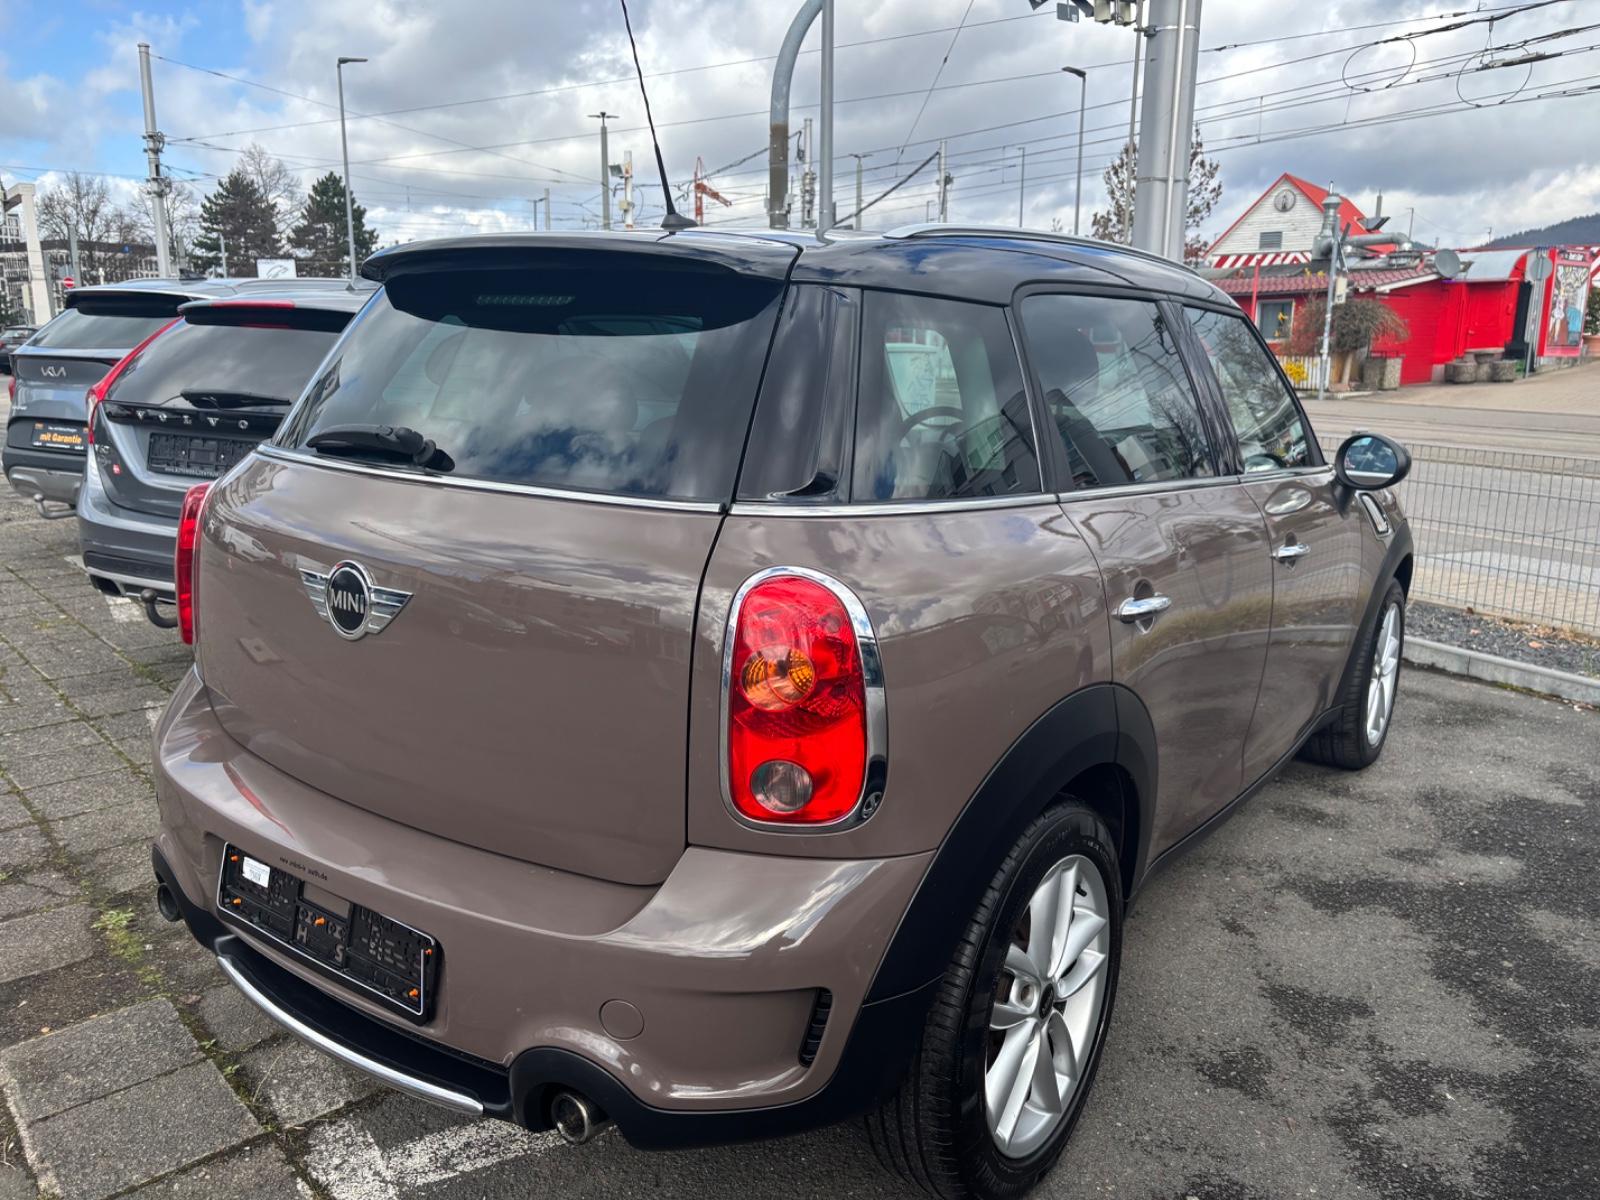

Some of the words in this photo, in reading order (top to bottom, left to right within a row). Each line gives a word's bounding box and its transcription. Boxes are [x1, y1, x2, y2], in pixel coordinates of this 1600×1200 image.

[136, 410, 249, 430] VOLVO
[51, 433, 82, 445] Garantie
[330, 588, 365, 614] MINI
